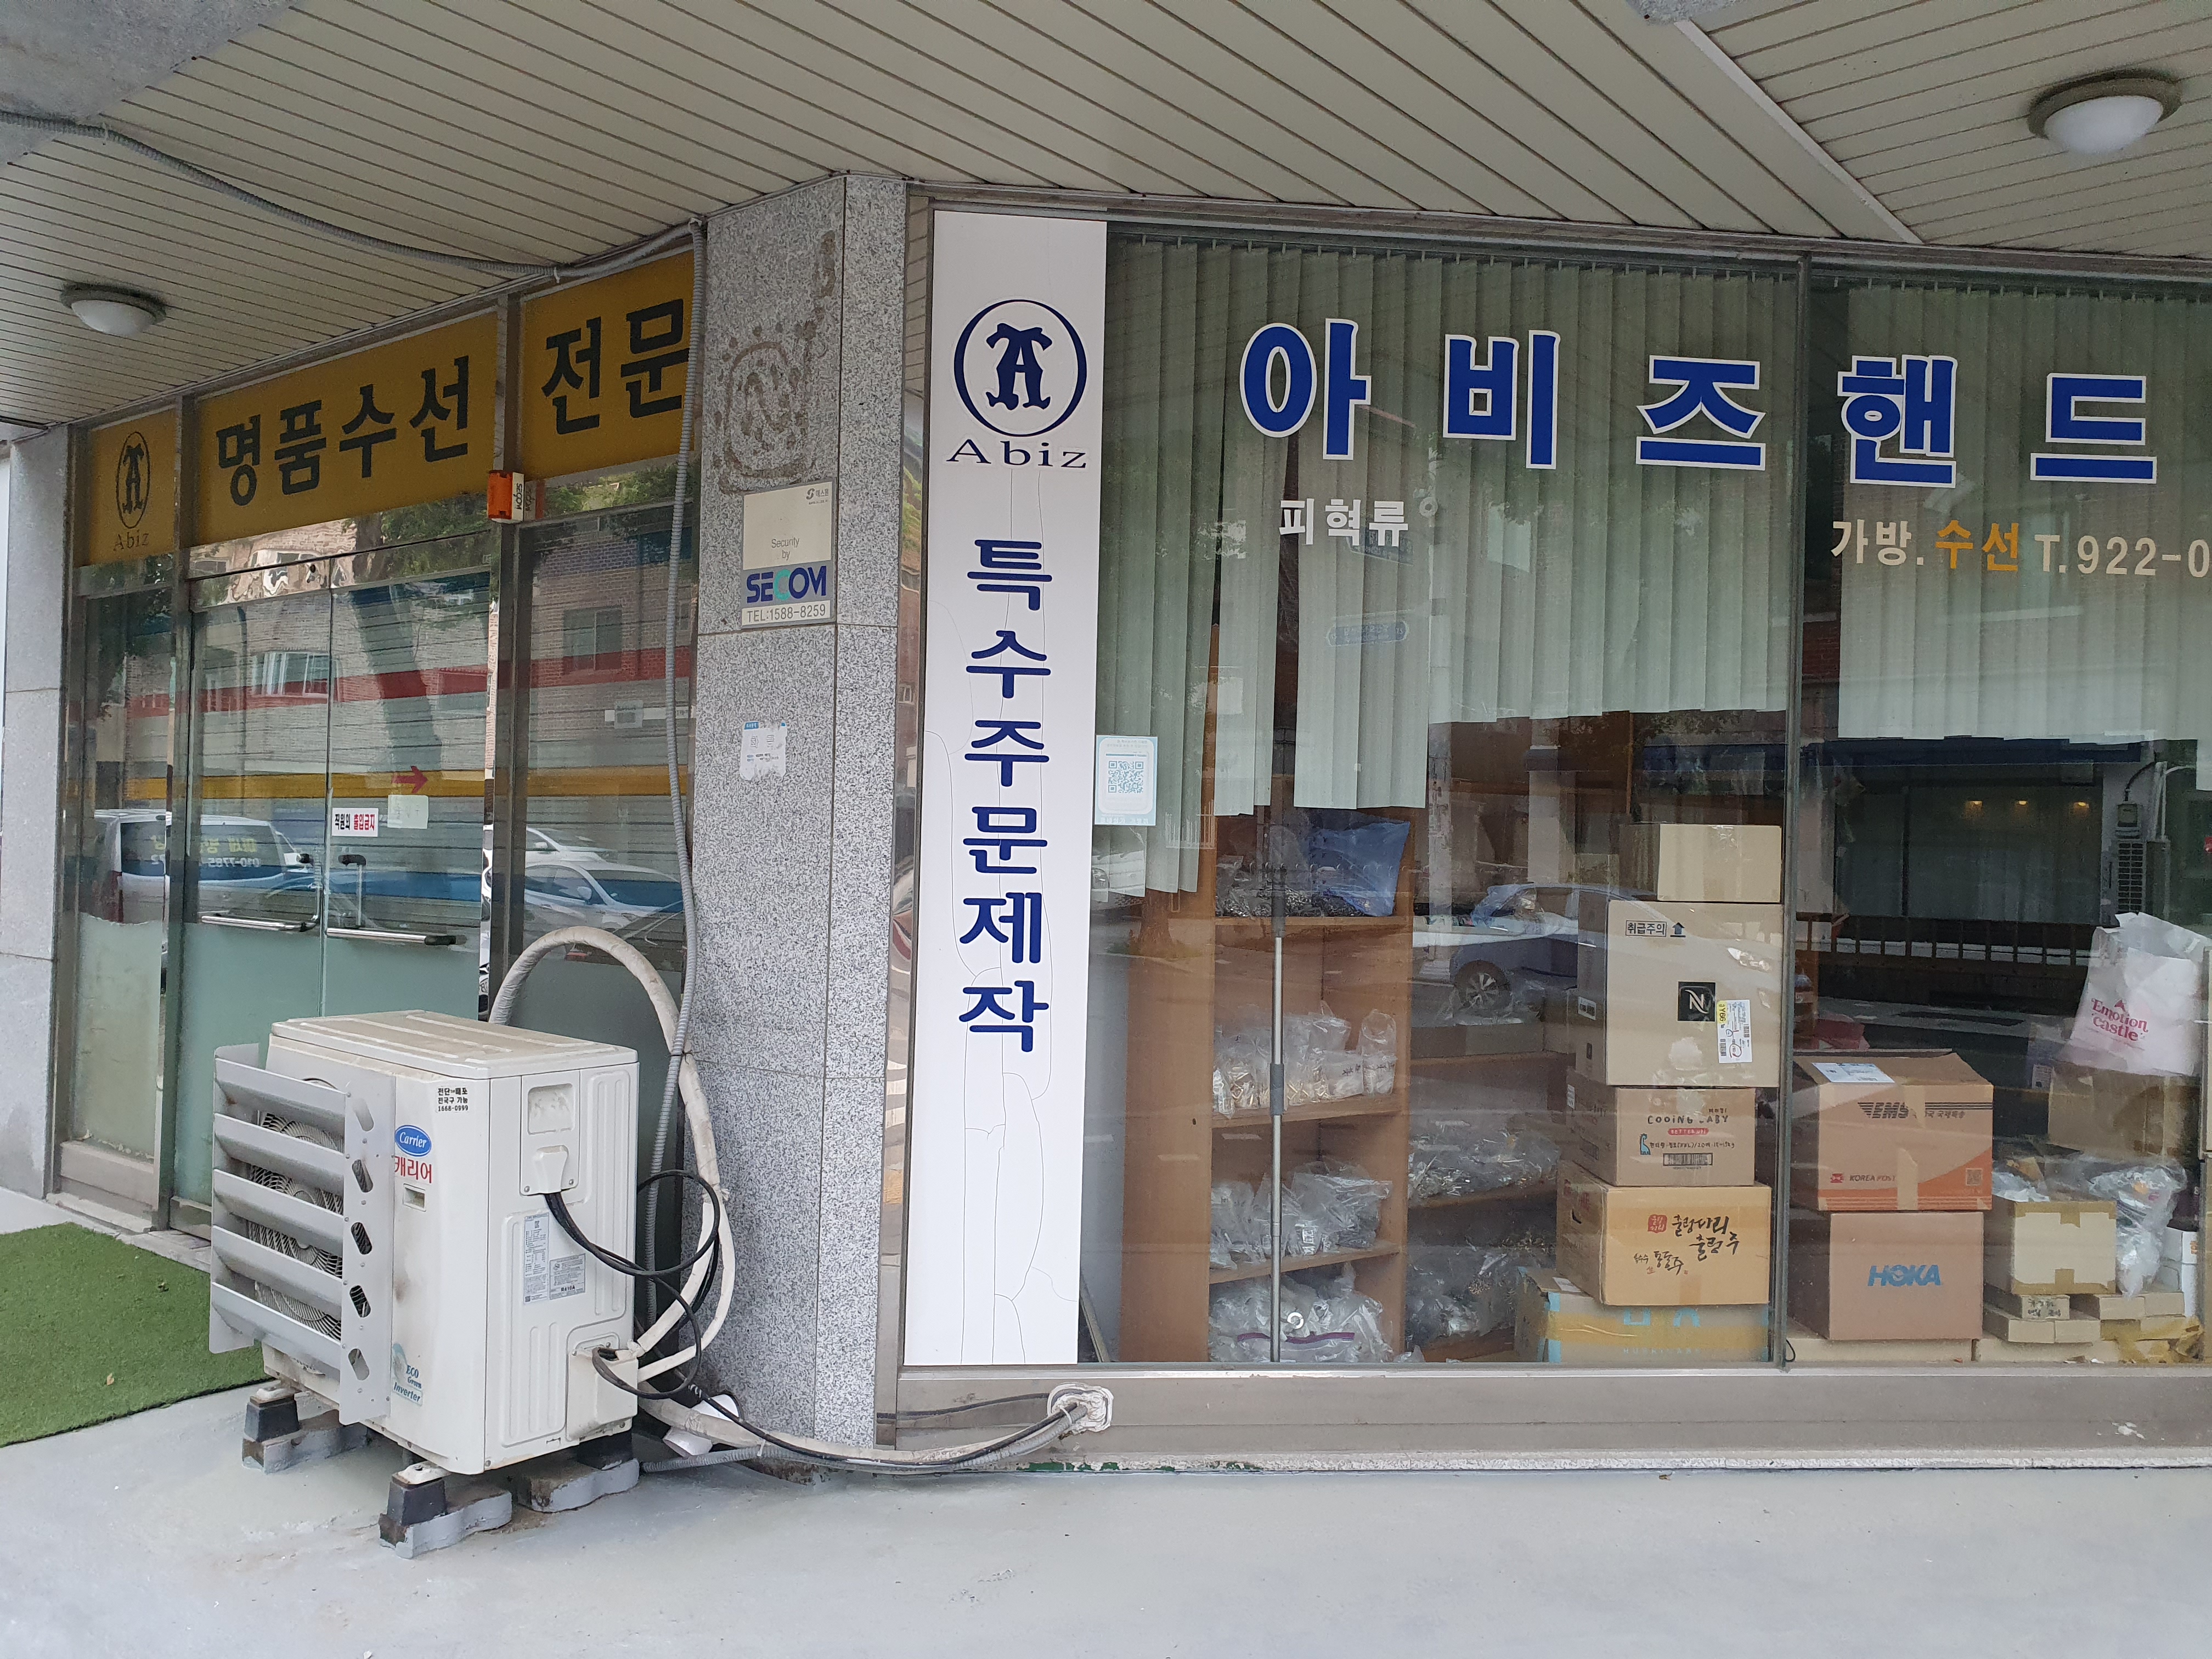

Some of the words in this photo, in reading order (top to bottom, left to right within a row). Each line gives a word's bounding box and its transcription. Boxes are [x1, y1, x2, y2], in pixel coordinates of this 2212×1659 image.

[541, 298, 690, 436] 전문
[1240, 318, 2157, 488] 아비즈핸드
[216, 355, 470, 506] 명품수선
[946, 439, 1087, 469] Abiz
[1279, 498, 1409, 547] 피혁류
[113, 529, 150, 551] Abiz
[771, 537, 800, 548] Security
[1935, 520, 2019, 572] 수선
[782, 550, 791, 560] by
[746, 566, 827, 603] SECOM
[747, 604, 826, 623] TEL:1588-8259
[958, 539, 1053, 1053] 특수주문제작
[335, 813, 351, 831] 직원외
[353, 813, 375, 831] 출입금지
[1627, 922, 1666, 935] 취급주의
[2091, 998, 2149, 1032] Emotion
[399, 1131, 427, 1148] Carrier
[392, 1155, 432, 1183] 캐리어
[1867, 1264, 1942, 1287] HOKA
[406, 1364, 419, 1379] ECO
[393, 1381, 421, 1402] Inverter
